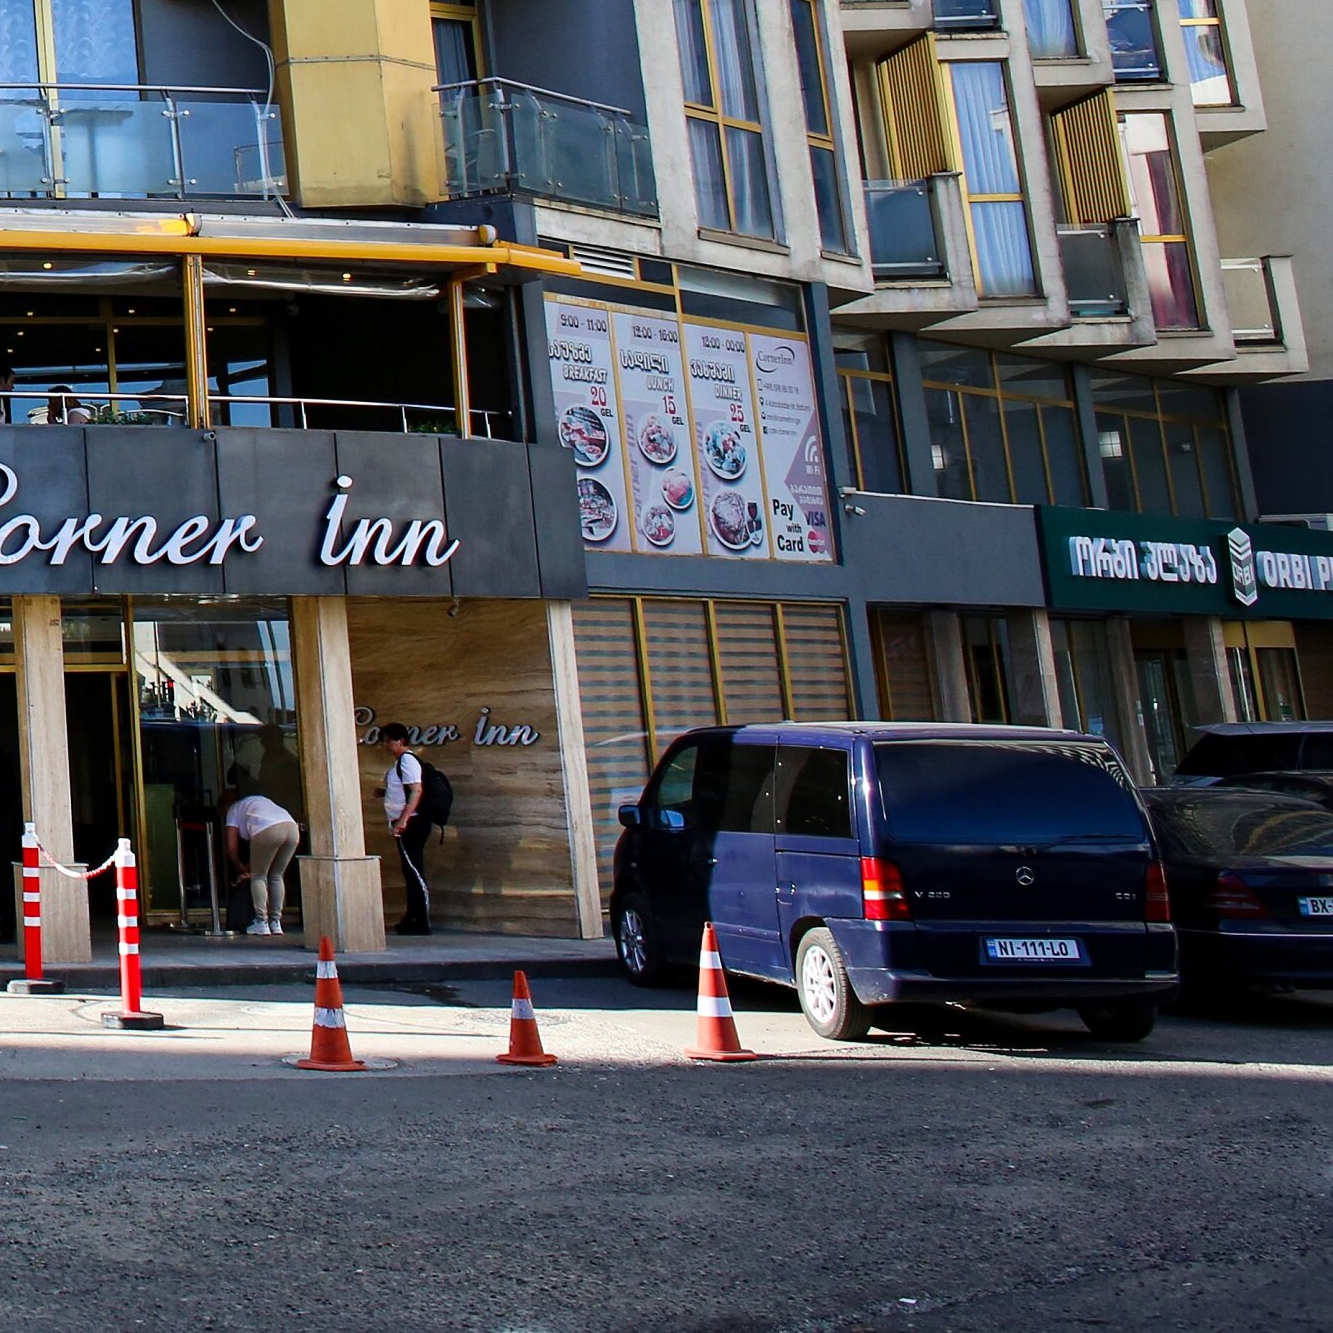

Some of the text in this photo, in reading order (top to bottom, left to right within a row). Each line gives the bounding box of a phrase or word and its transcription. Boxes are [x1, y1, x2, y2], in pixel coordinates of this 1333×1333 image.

[559, 313, 607, 333] 9:00 11:00
[619, 349, 669, 375] სადილი
[563, 364, 608, 385] BREAKFAST
[646, 375, 675, 392] LUNCH
[590, 386, 607, 406] 20
[715, 384, 743, 402] DINNER
[600, 408, 614, 418] GEL
[662, 395, 676, 415] 15
[730, 403, 744, 422] 25
[671, 416, 684, 426] GEL
[739, 424, 751, 433] GEL
[772, 498, 793, 521] Pay
[786, 522, 802, 533] with
[804, 511, 826, 527] VISA
[777, 534, 804, 552] Card
[1071, 536, 1217, 584] ორბი პლაზა
[1256, 550, 1313, 590] ORBI
[1309, 899, 1333, 914] BX-
